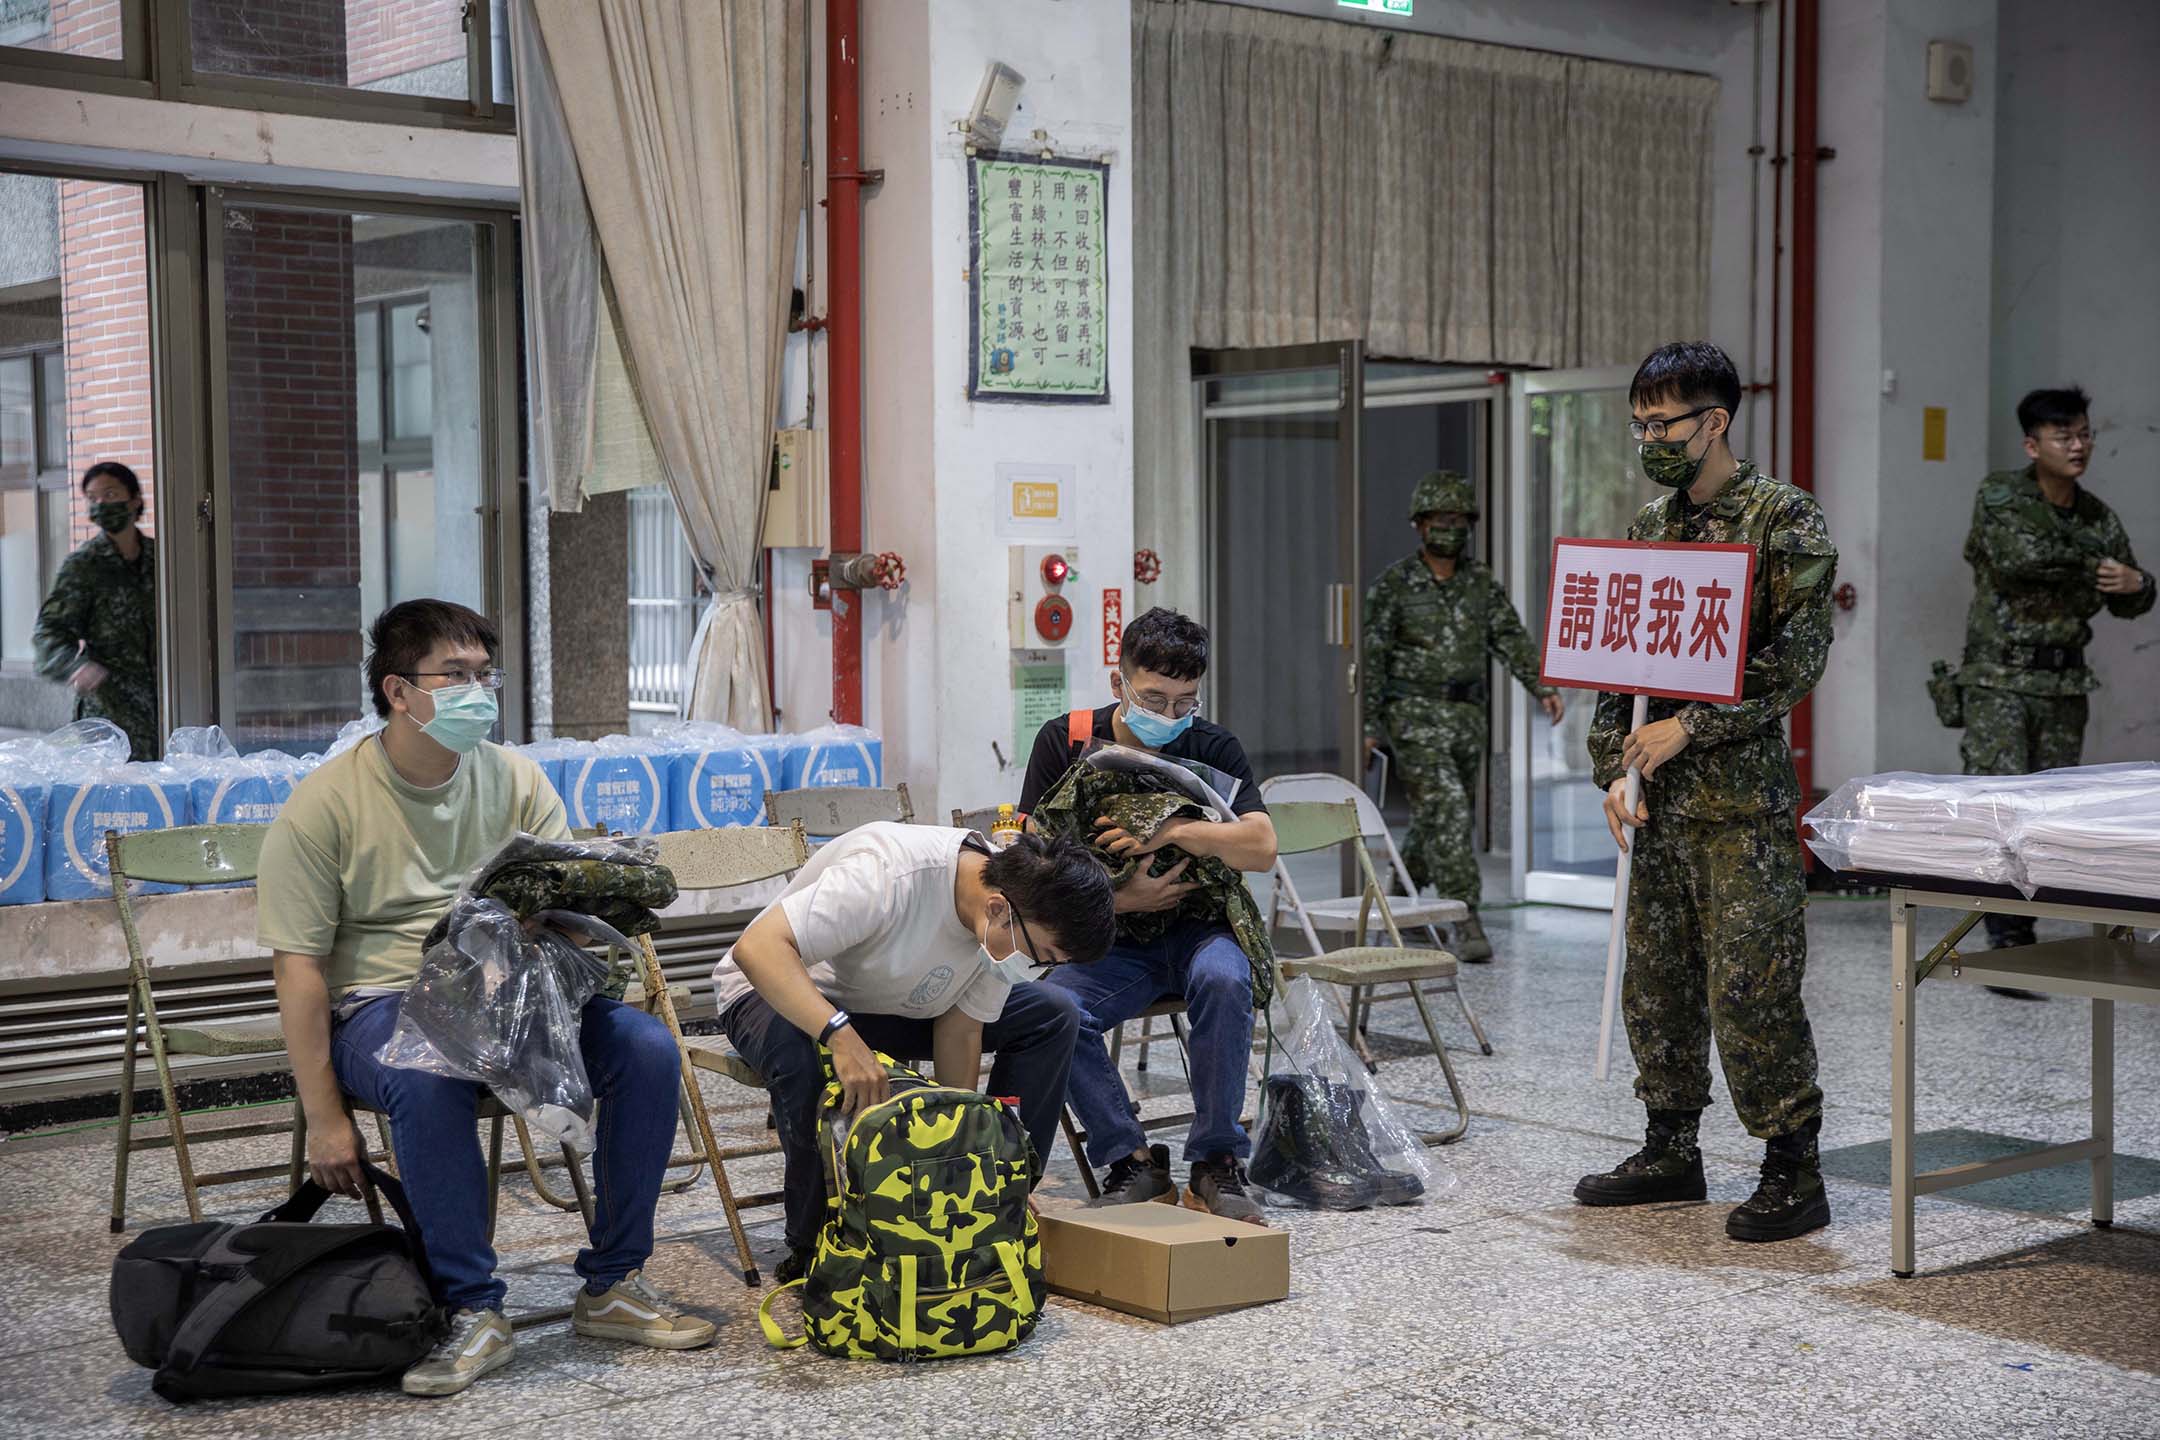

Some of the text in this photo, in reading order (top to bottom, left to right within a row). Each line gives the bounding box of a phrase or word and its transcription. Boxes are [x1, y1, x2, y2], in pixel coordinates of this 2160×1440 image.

[1030, 180, 1049, 365] 片綠林大地，也可
[1074, 184, 1092, 367] 將回收的資源再利
[1558, 570, 1732, 662] 請跟我來
